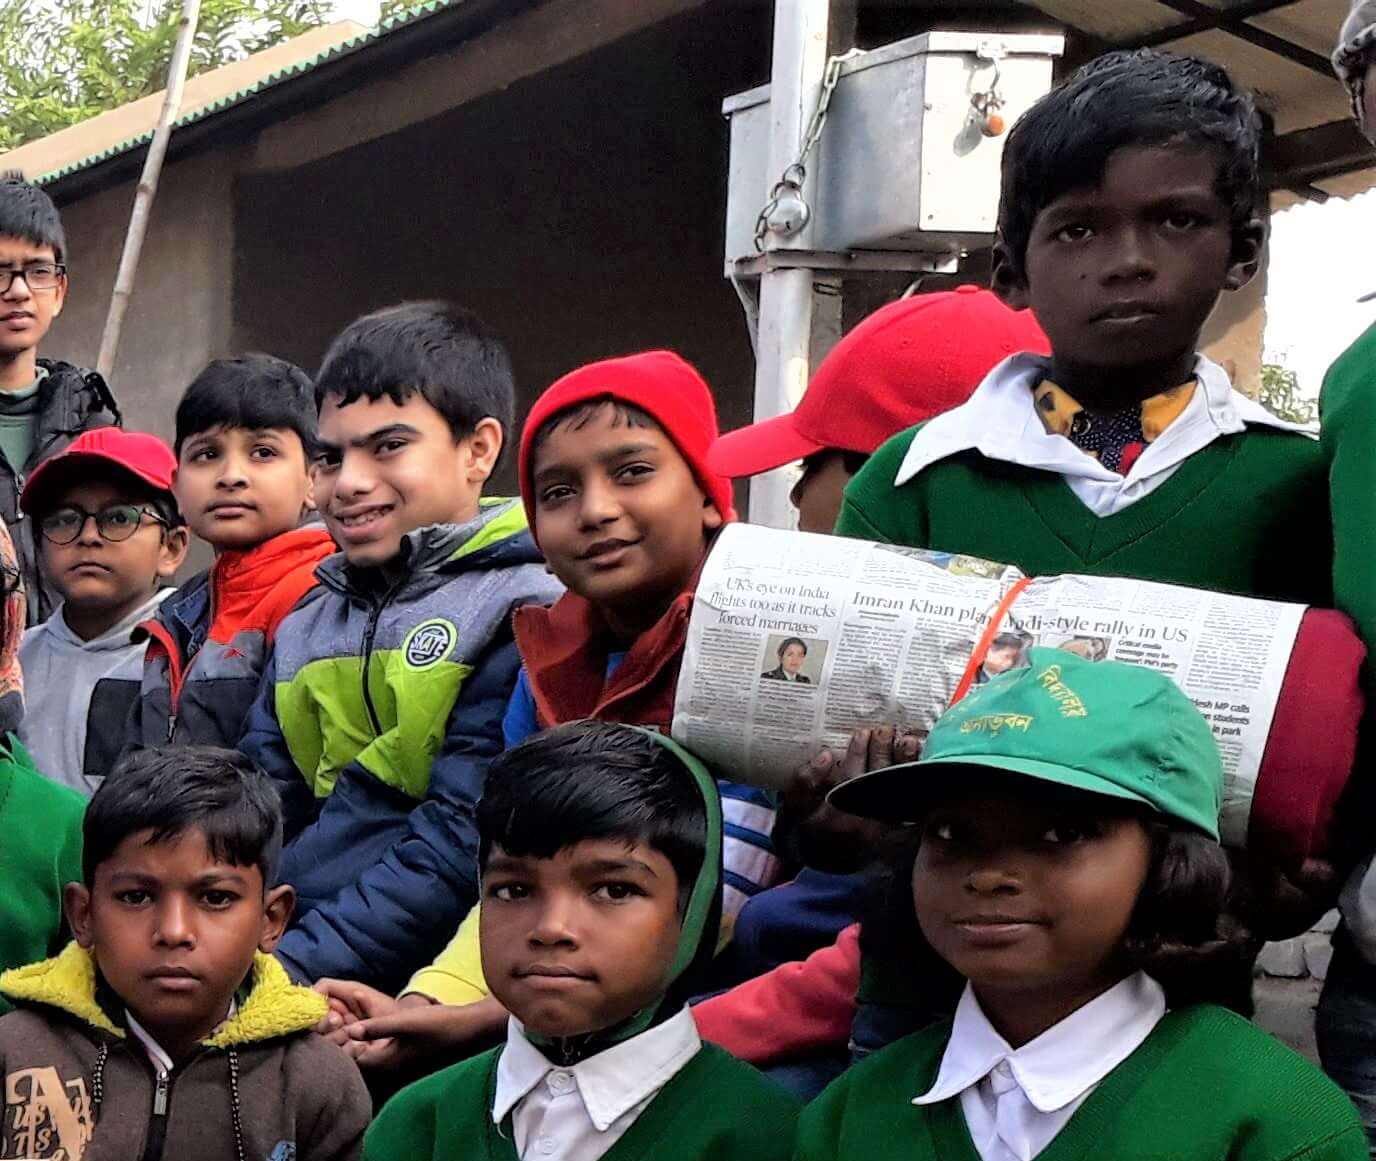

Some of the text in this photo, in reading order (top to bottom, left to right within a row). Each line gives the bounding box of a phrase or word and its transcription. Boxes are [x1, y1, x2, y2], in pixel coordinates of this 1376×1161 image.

[709, 591, 837, 618] flights too as it tracks
[756, 583, 778, 596] eye
[780, 587, 796, 596] on
[799, 585, 830, 600] India
[718, 611, 819, 636] forced marriages
[852, 591, 904, 610] Imran
[908, 599, 955, 617] Khan
[958, 606, 994, 627] plan
[1093, 619, 1135, 641] rally
[1138, 623, 1156, 639] in
[1161, 626, 1190, 643] US
